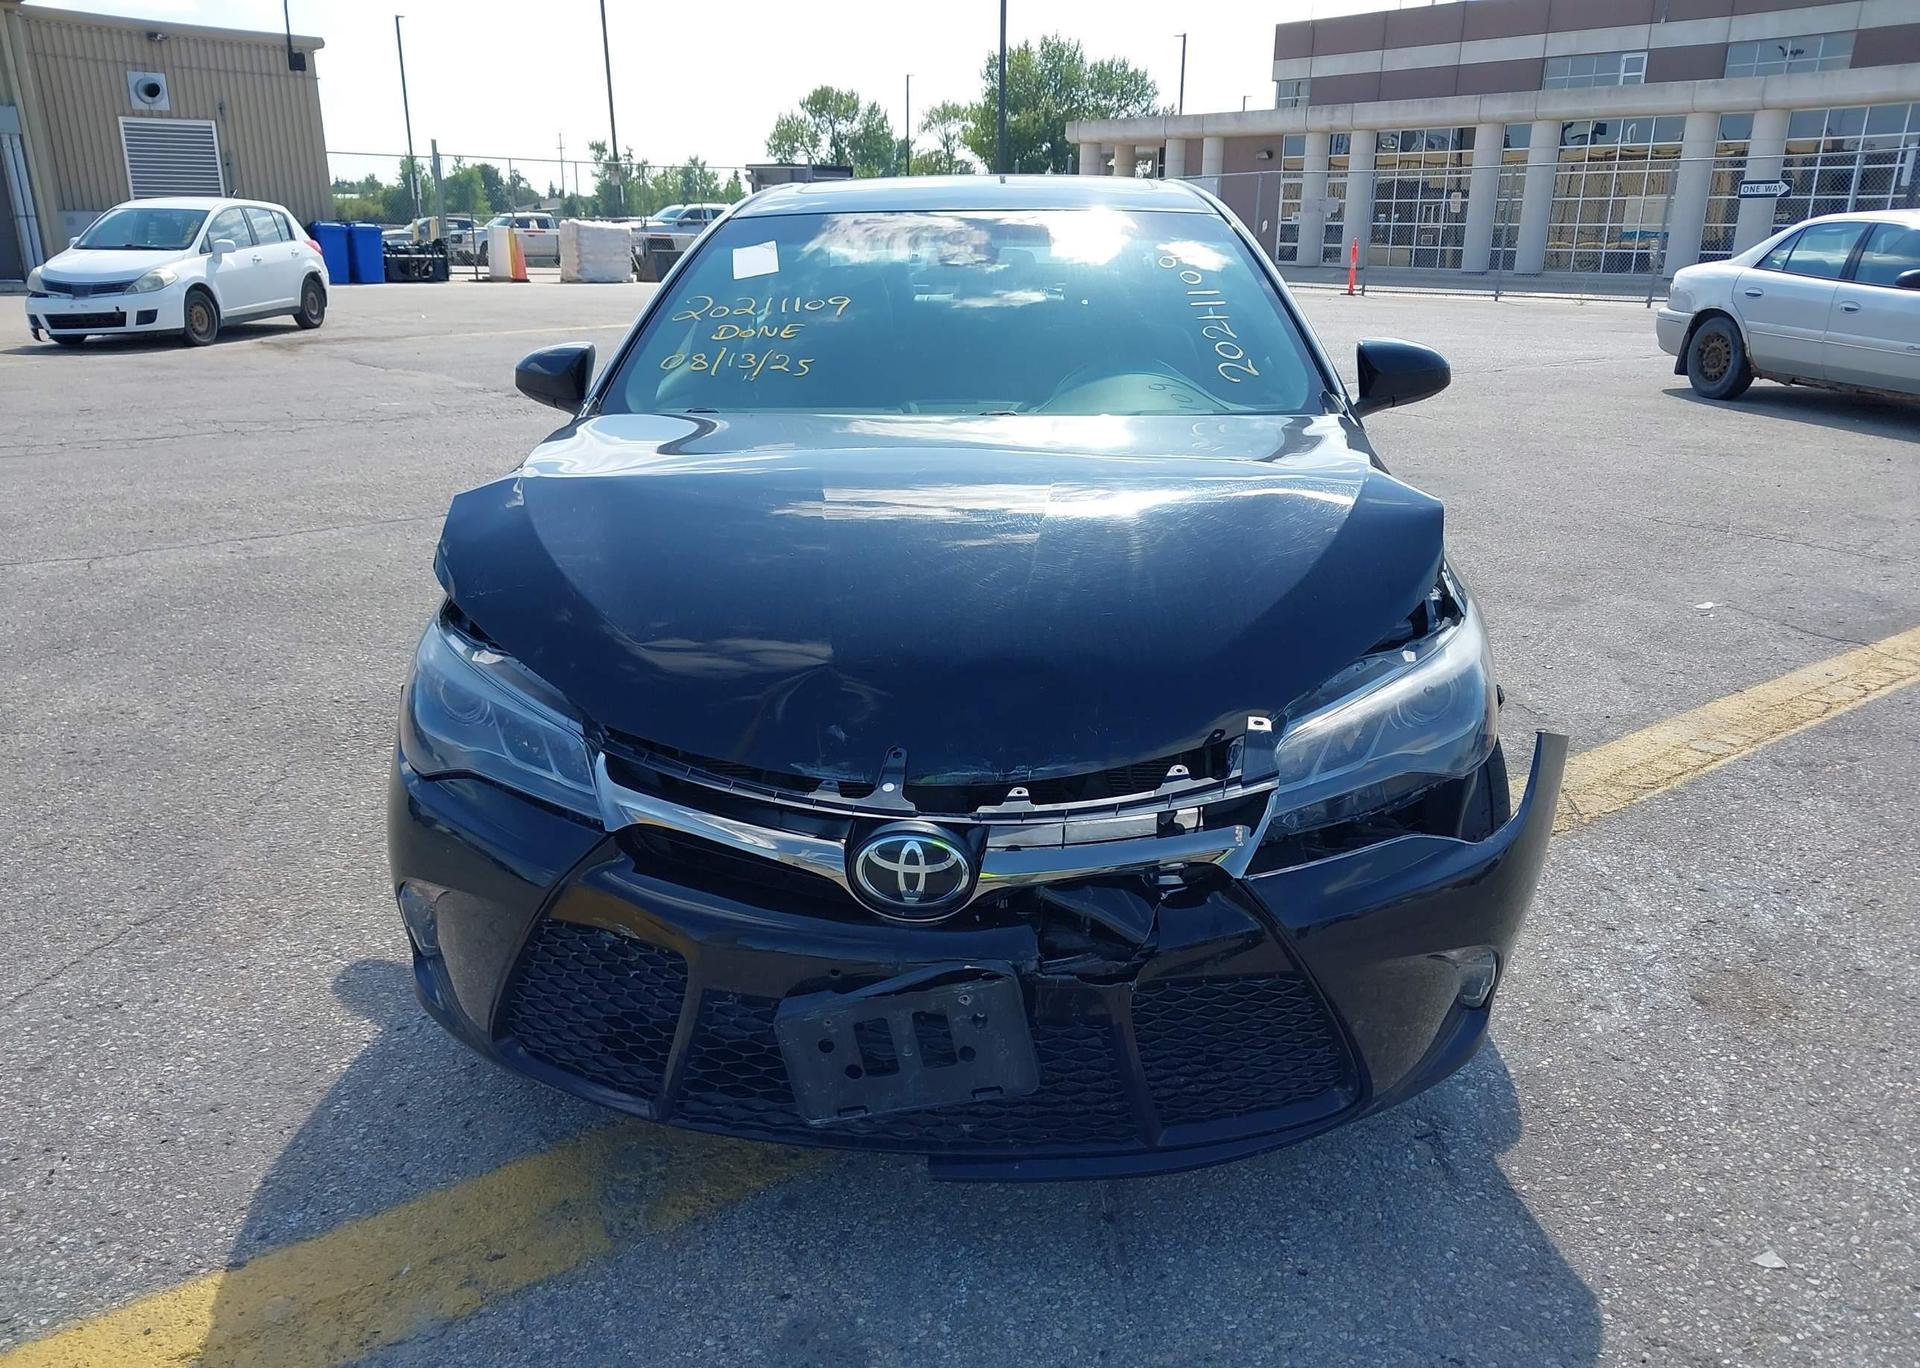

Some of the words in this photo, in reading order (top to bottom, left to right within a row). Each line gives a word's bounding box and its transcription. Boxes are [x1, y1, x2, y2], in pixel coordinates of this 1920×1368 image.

[1743, 185, 1761, 193] ONE
[1764, 185, 1783, 193] WAY
[672, 295, 851, 322] 20211109
[1158, 255, 1260, 383] 20211109
[711, 323, 805, 341] DONE
[660, 347, 815, 382] 08/13/25
